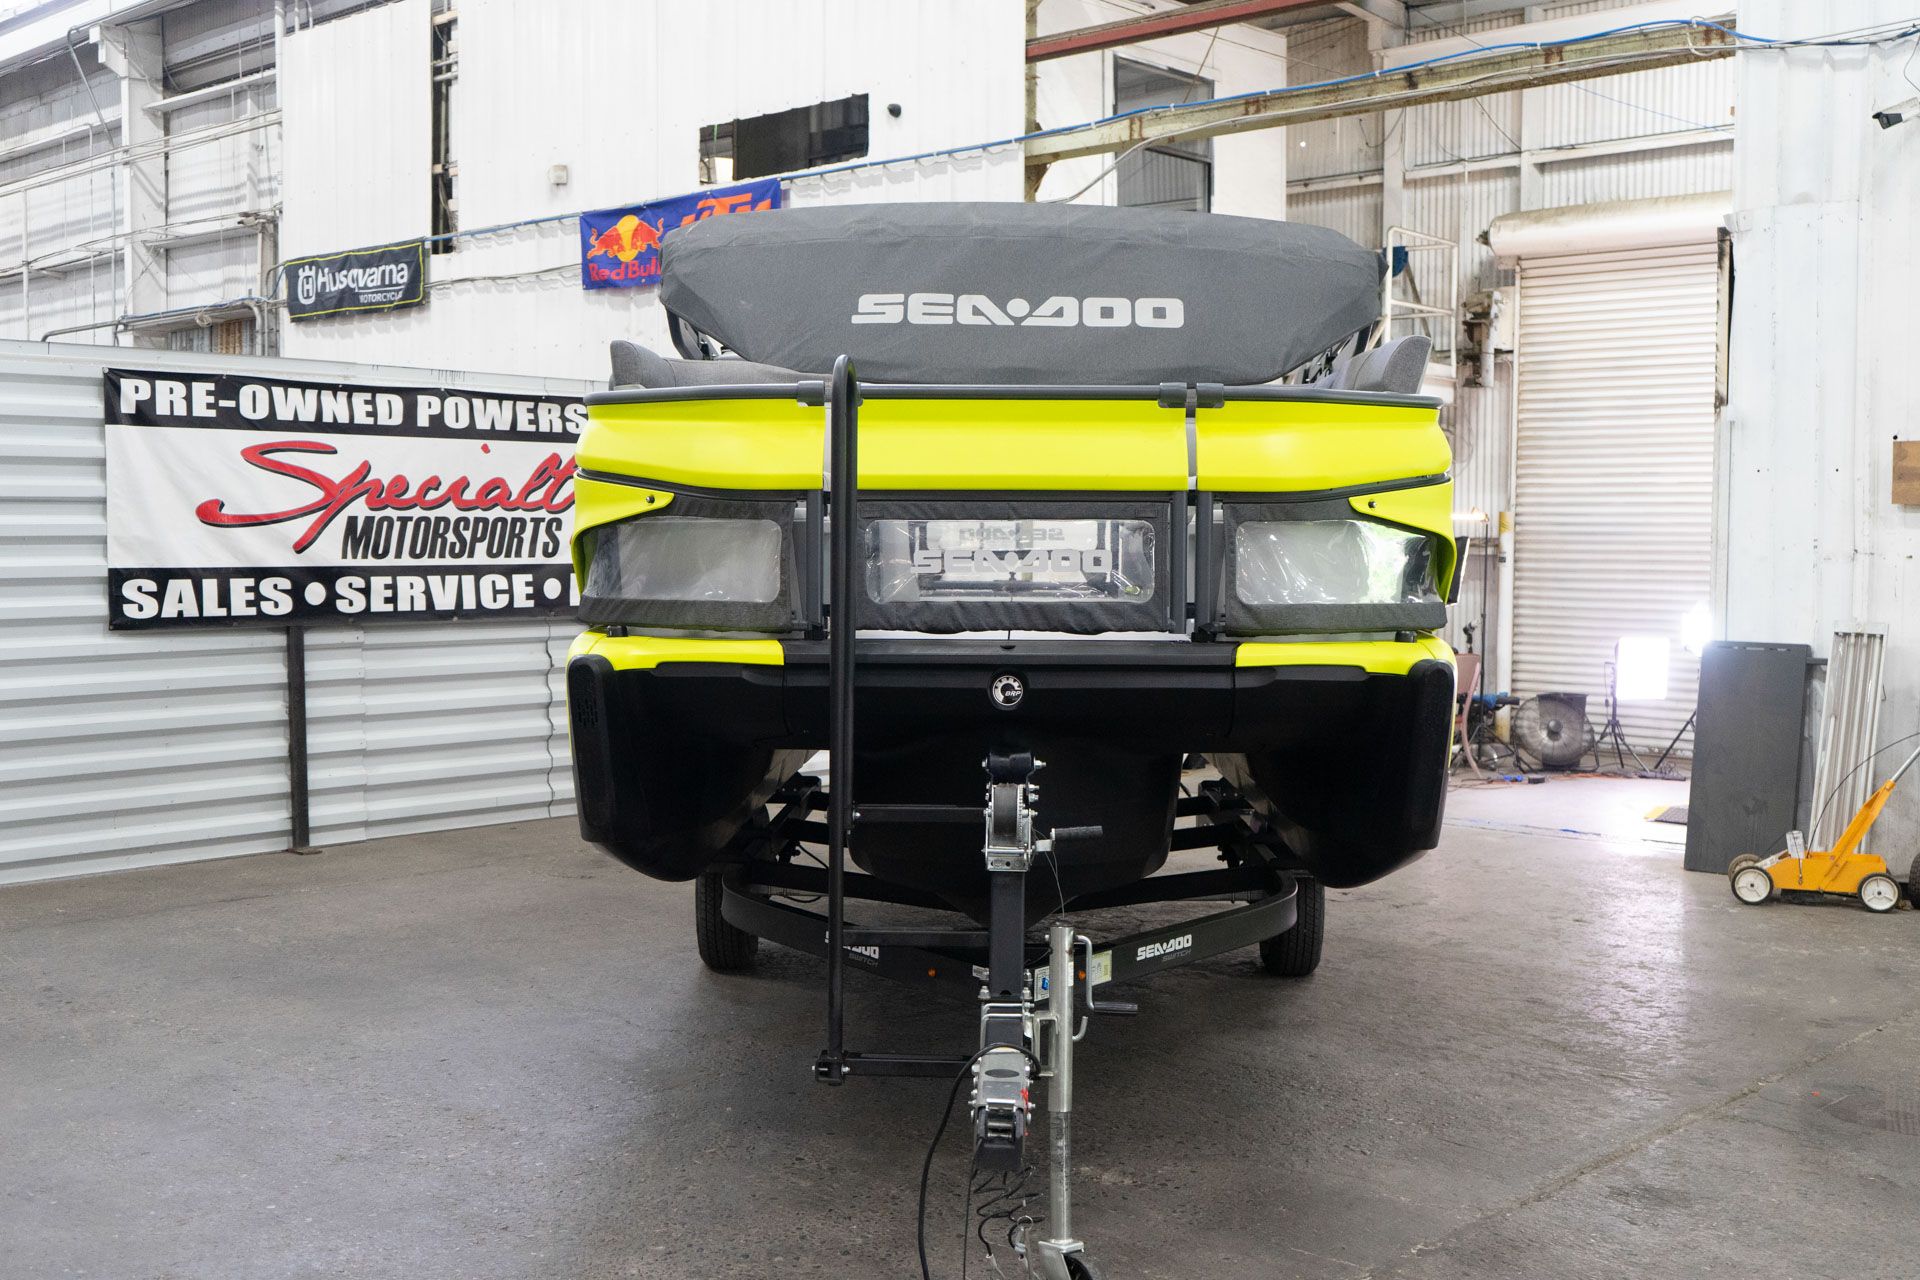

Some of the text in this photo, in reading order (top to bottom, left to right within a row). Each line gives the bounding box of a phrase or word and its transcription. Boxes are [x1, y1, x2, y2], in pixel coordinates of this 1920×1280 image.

[318, 263, 408, 292] Husqvarna
[588, 262, 625, 281] Red
[120, 379, 403, 426] PRE-OWNED
[342, 516, 562, 560] MOTORSPORTS
[122, 577, 293, 619] SALES
[335, 574, 535, 613] SERVICE
